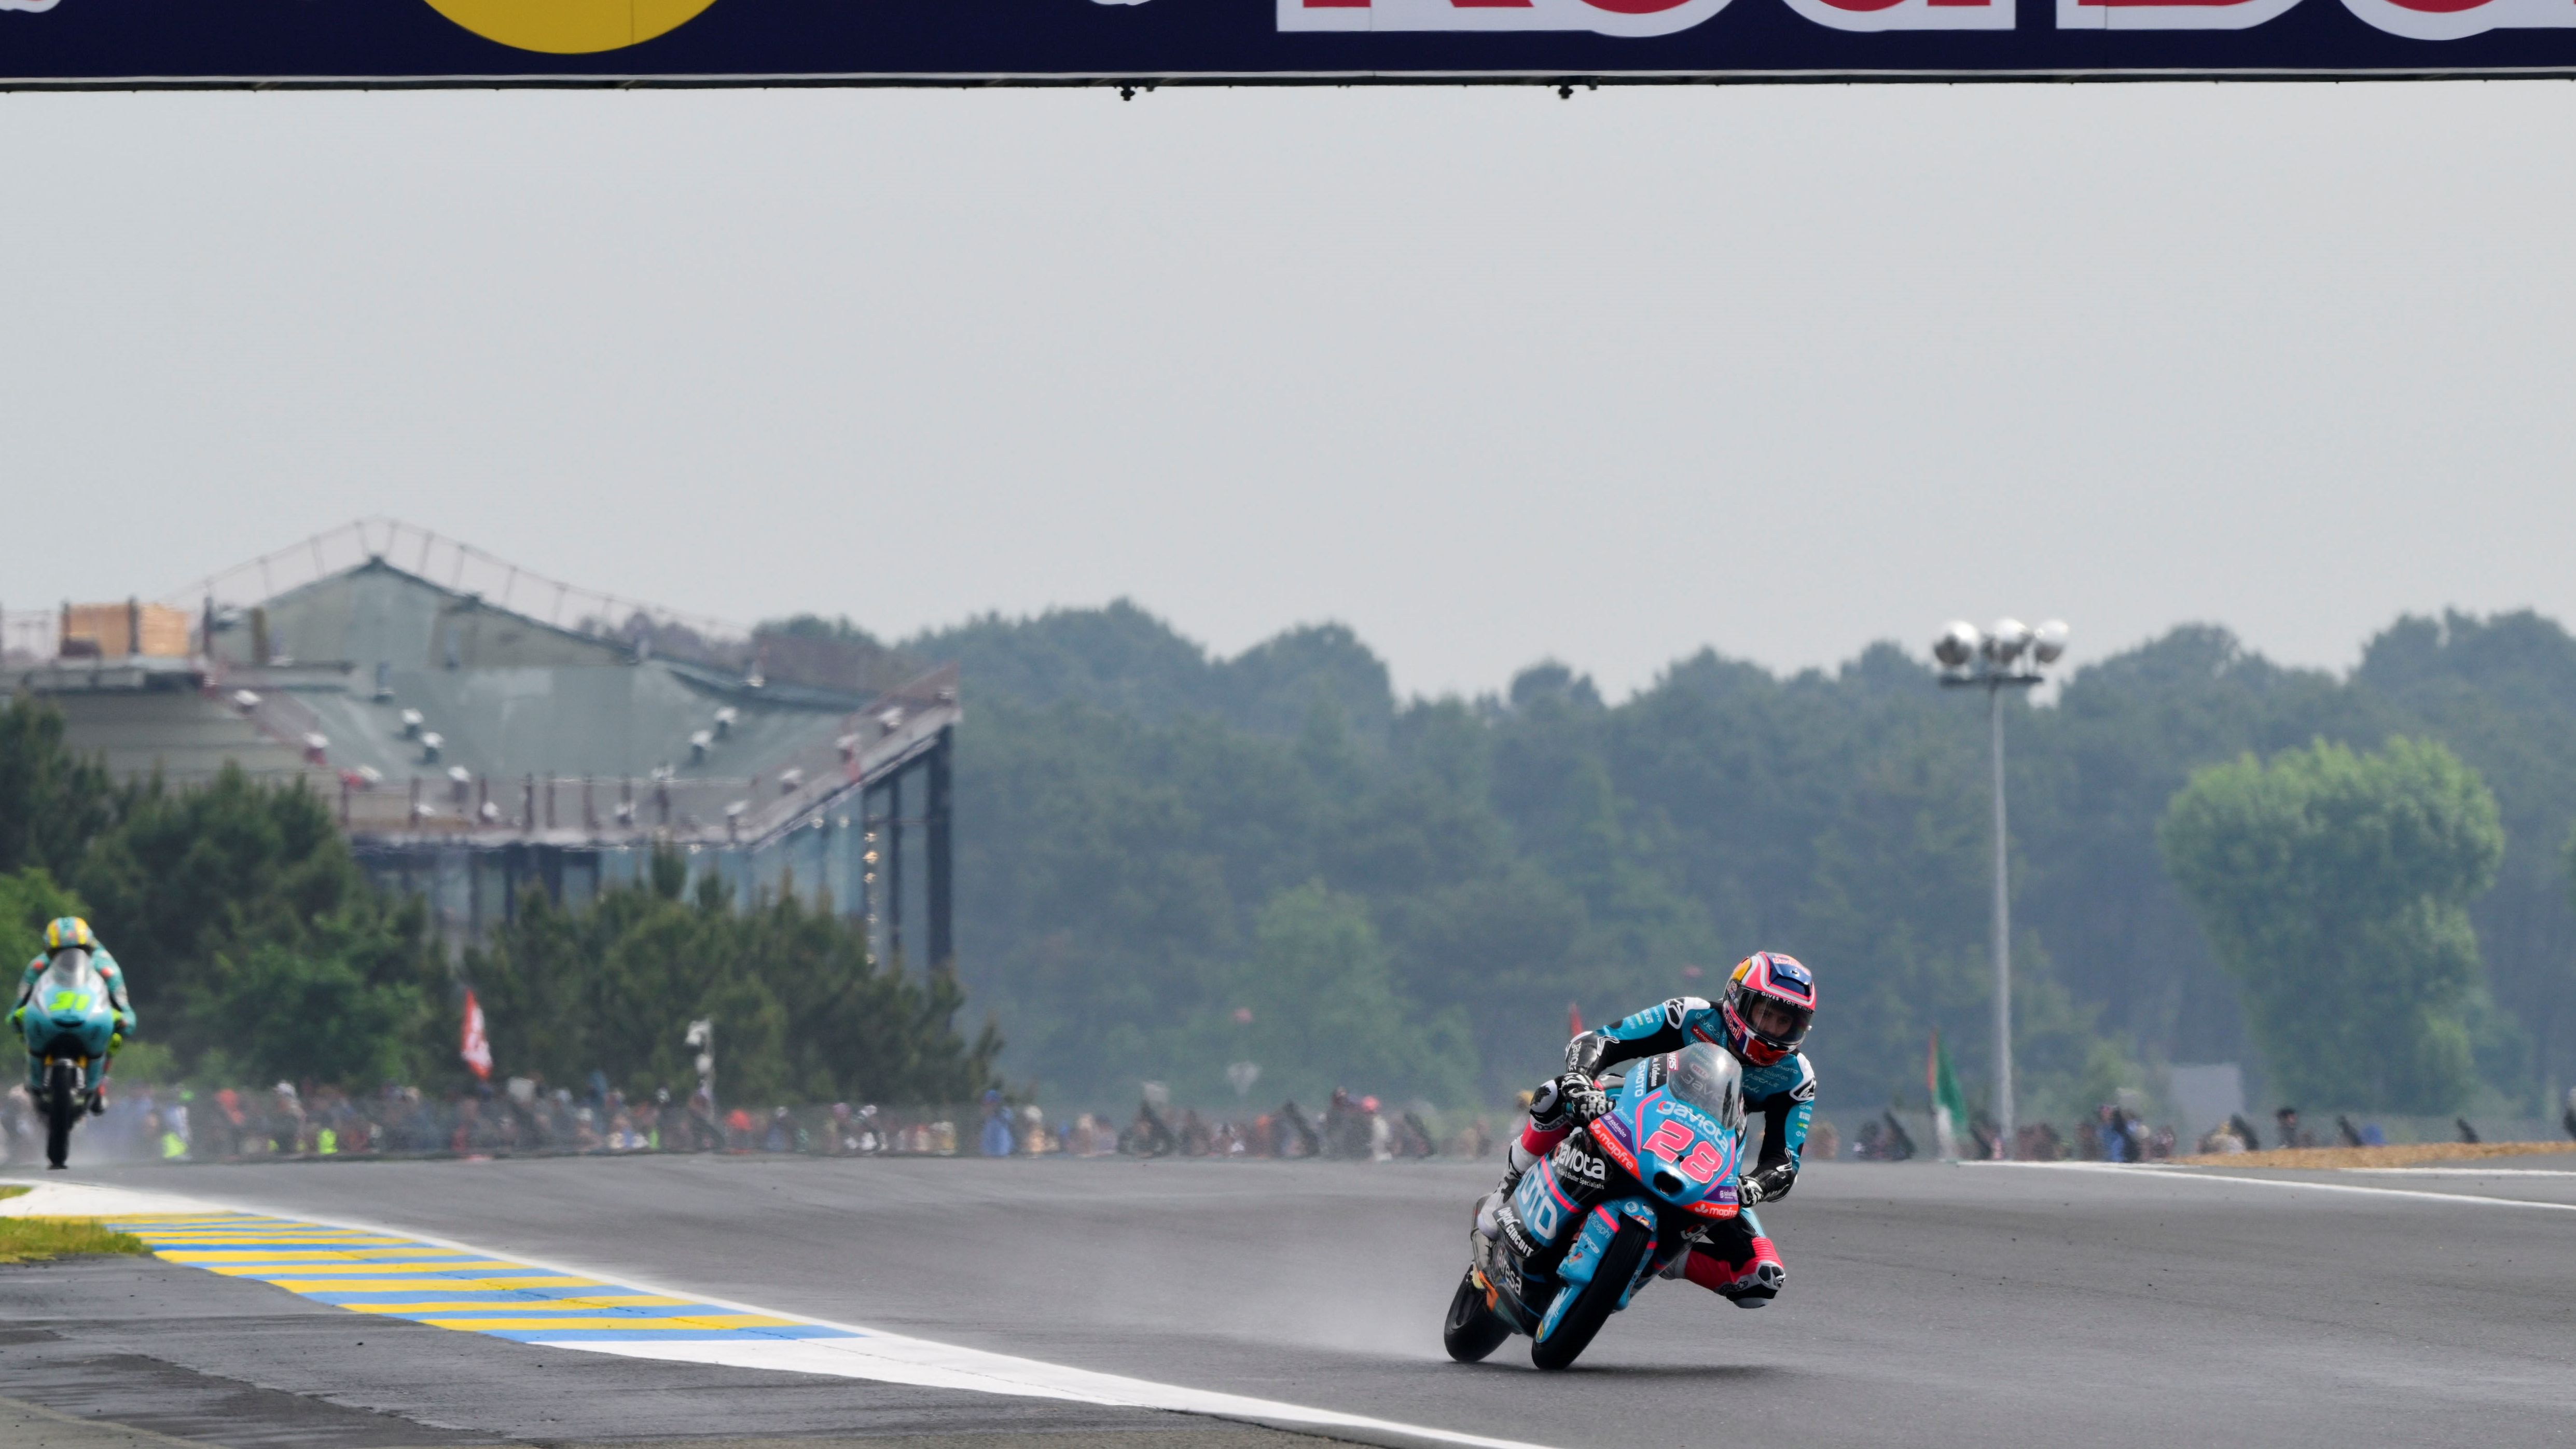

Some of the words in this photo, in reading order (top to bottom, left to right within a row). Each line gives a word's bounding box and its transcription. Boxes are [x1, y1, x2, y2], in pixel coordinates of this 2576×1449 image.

[1761, 991, 1779, 1001] GIVES
[1783, 999, 1795, 1007] YOU
[1695, 1012, 1721, 1039] gaviota
[1669, 1053, 1677, 1070] WRS
[1610, 1119, 1627, 1138] solunion
[1656, 1100, 1729, 1153] gaviota
[1551, 1141, 1605, 1180] gaviota
[1599, 1133, 1633, 1170] mapfre
[1642, 1119, 1723, 1184] 28
[1579, 1177, 1604, 1190] Specialists
[1709, 1207, 1738, 1218] mapfre
[1505, 1224, 1534, 1257] CIRCUIT
